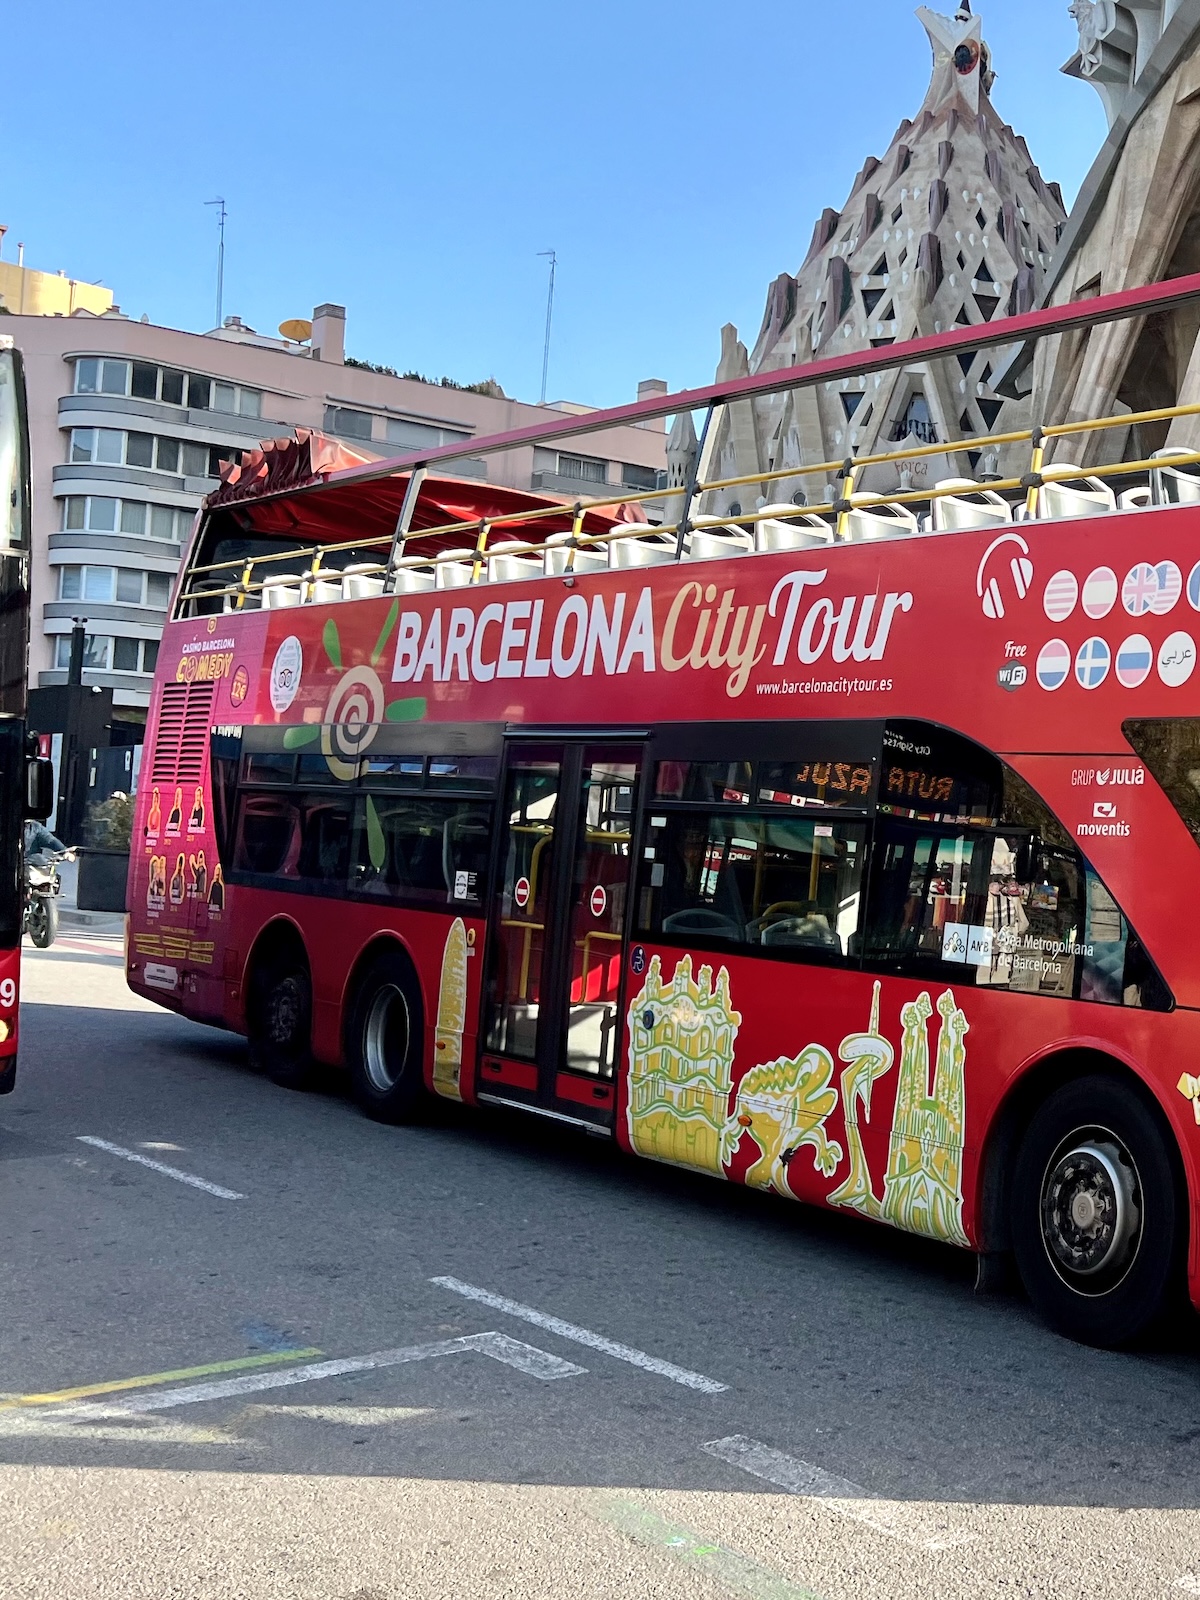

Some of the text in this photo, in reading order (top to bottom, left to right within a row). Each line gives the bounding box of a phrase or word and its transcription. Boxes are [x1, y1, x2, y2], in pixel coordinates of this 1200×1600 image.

[391, 568, 912, 698] BARCELONA City Tour
[183, 638, 235, 653] CASINO BARCELONA
[1004, 641, 1027, 658] Free
[176, 652, 234, 683] COMEDY
[1161, 649, 1192, 668] عربي
[756, 675, 893, 698] www.barcelonacitytour.es
[1071, 769, 1095, 786] GRUP
[1077, 820, 1130, 836] moventis
[1024, 934, 1094, 957] Metropolitana
[997, 953, 1062, 975] de Barcelona
